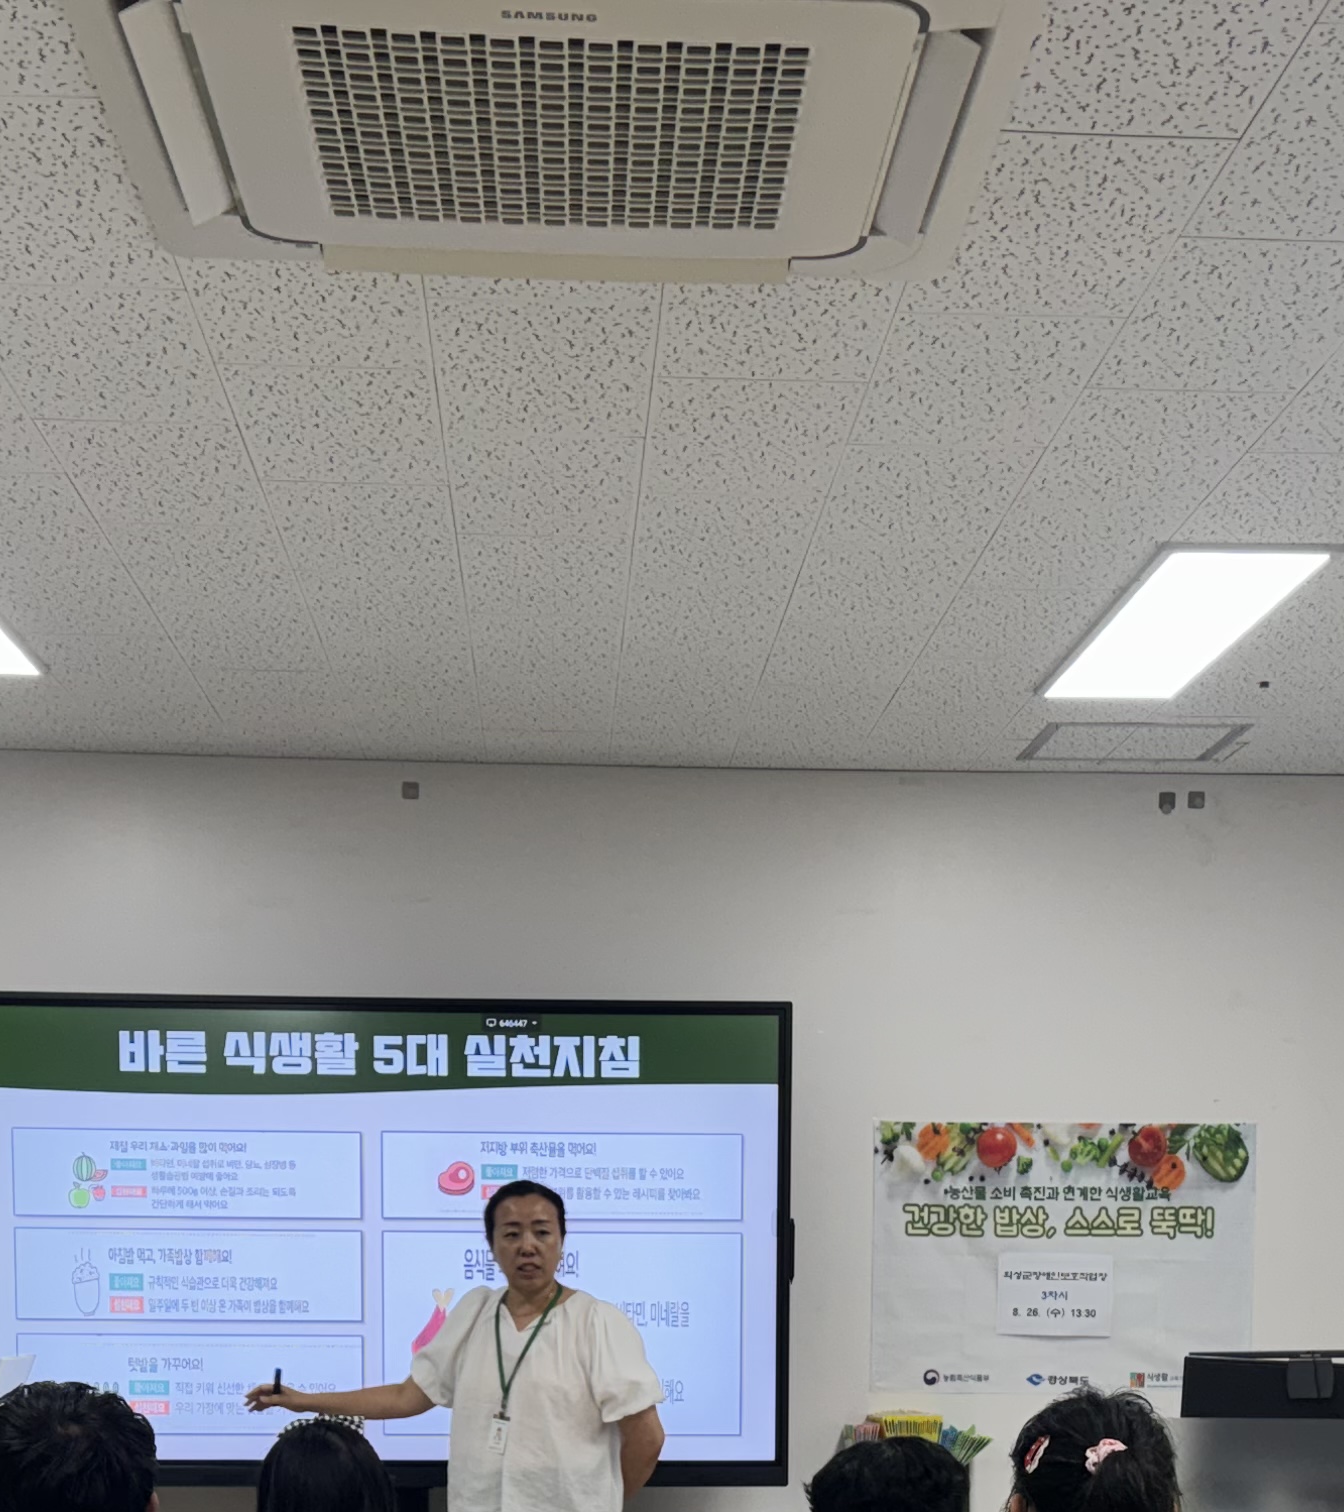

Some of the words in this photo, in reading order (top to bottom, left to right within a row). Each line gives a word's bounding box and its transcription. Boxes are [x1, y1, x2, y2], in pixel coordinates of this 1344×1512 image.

[501, 10, 598, 23] SAMSUNG
[118, 1029, 207, 1074] 바른
[223, 1031, 359, 1075] 식생활
[373, 1033, 449, 1077] 5대
[463, 1034, 641, 1078] 실천지침
[130, 1140, 147, 1152] 우리
[510, 1141, 528, 1156] 부위
[568, 1142, 597, 1157] 먹어요!
[649, 1168, 658, 1179] 수
[660, 1168, 684, 1180] 있어요
[603, 1188, 612, 1200] 수
[990, 1186, 1015, 1200] 소비
[1019, 1186, 1059, 1200] 촉진과
[1063, 1186, 1103, 1200] 연계한
[1106, 1186, 1171, 1201] 식생활교육
[903, 1203, 987, 1237] 건강한
[993, 1204, 1056, 1240] 밥상,
[1064, 1206, 1143, 1238] 스스로
[1150, 1206, 1216, 1239] 뚝딱!
[109, 1247, 134, 1264] 아침밥
[158, 1248, 192, 1265] 가족밥상
[148, 1275, 179, 1290] 규칙적인
[181, 1276, 220, 1291] 식습관으로
[181, 1300, 189, 1313] 두
[201, 1300, 216, 1313] 이상
[1046, 1307, 1065, 1318] (수)
[651, 1301, 690, 1328] 미네랄을
[128, 1357, 158, 1373] 텃밭을
[161, 1358, 204, 1371] 가꾸어요!
[1047, 1375, 1089, 1386] 경상북도
[1147, 1372, 1168, 1383] 식생활
[175, 1382, 193, 1395] 직접
[196, 1382, 214, 1395] 키워
[217, 1382, 245, 1395] 신선한
[175, 1402, 193, 1415] 우리
[196, 1402, 223, 1415] 가정에
